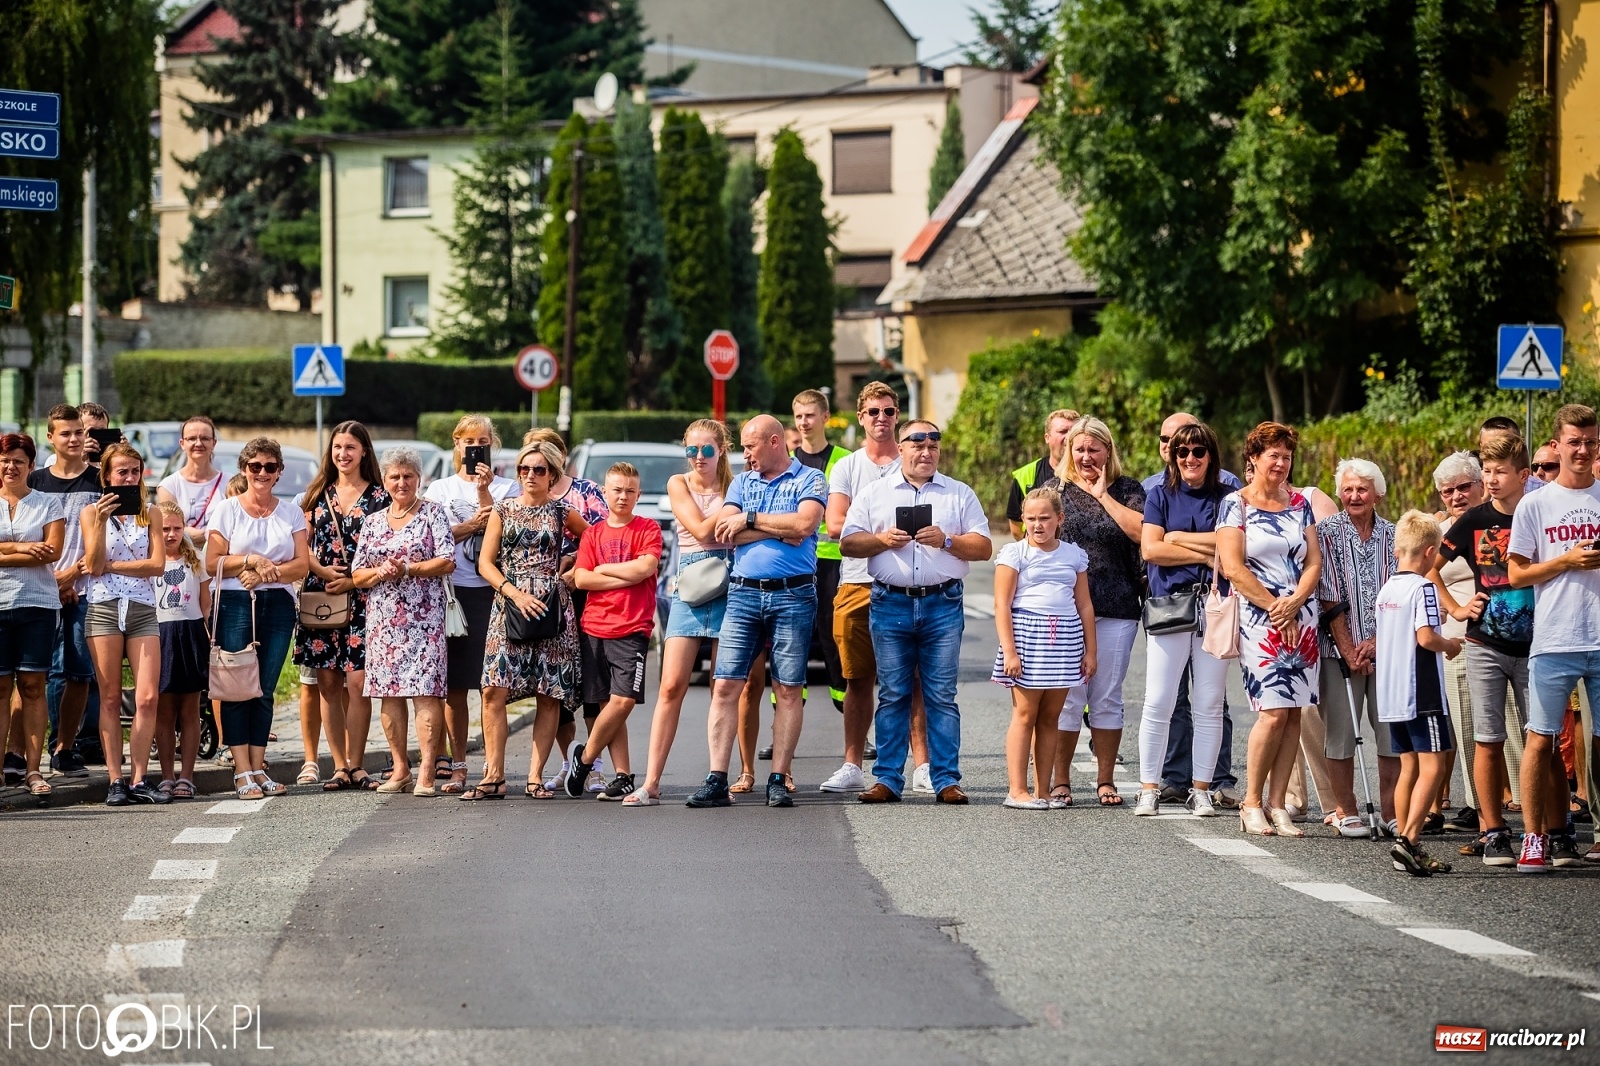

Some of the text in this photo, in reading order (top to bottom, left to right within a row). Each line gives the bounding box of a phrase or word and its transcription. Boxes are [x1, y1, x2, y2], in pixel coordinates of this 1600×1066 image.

[0, 131, 47, 152] SKO
[0, 184, 54, 207] mskiego
[709, 347, 736, 362] STOP
[523, 358, 554, 379] 40
